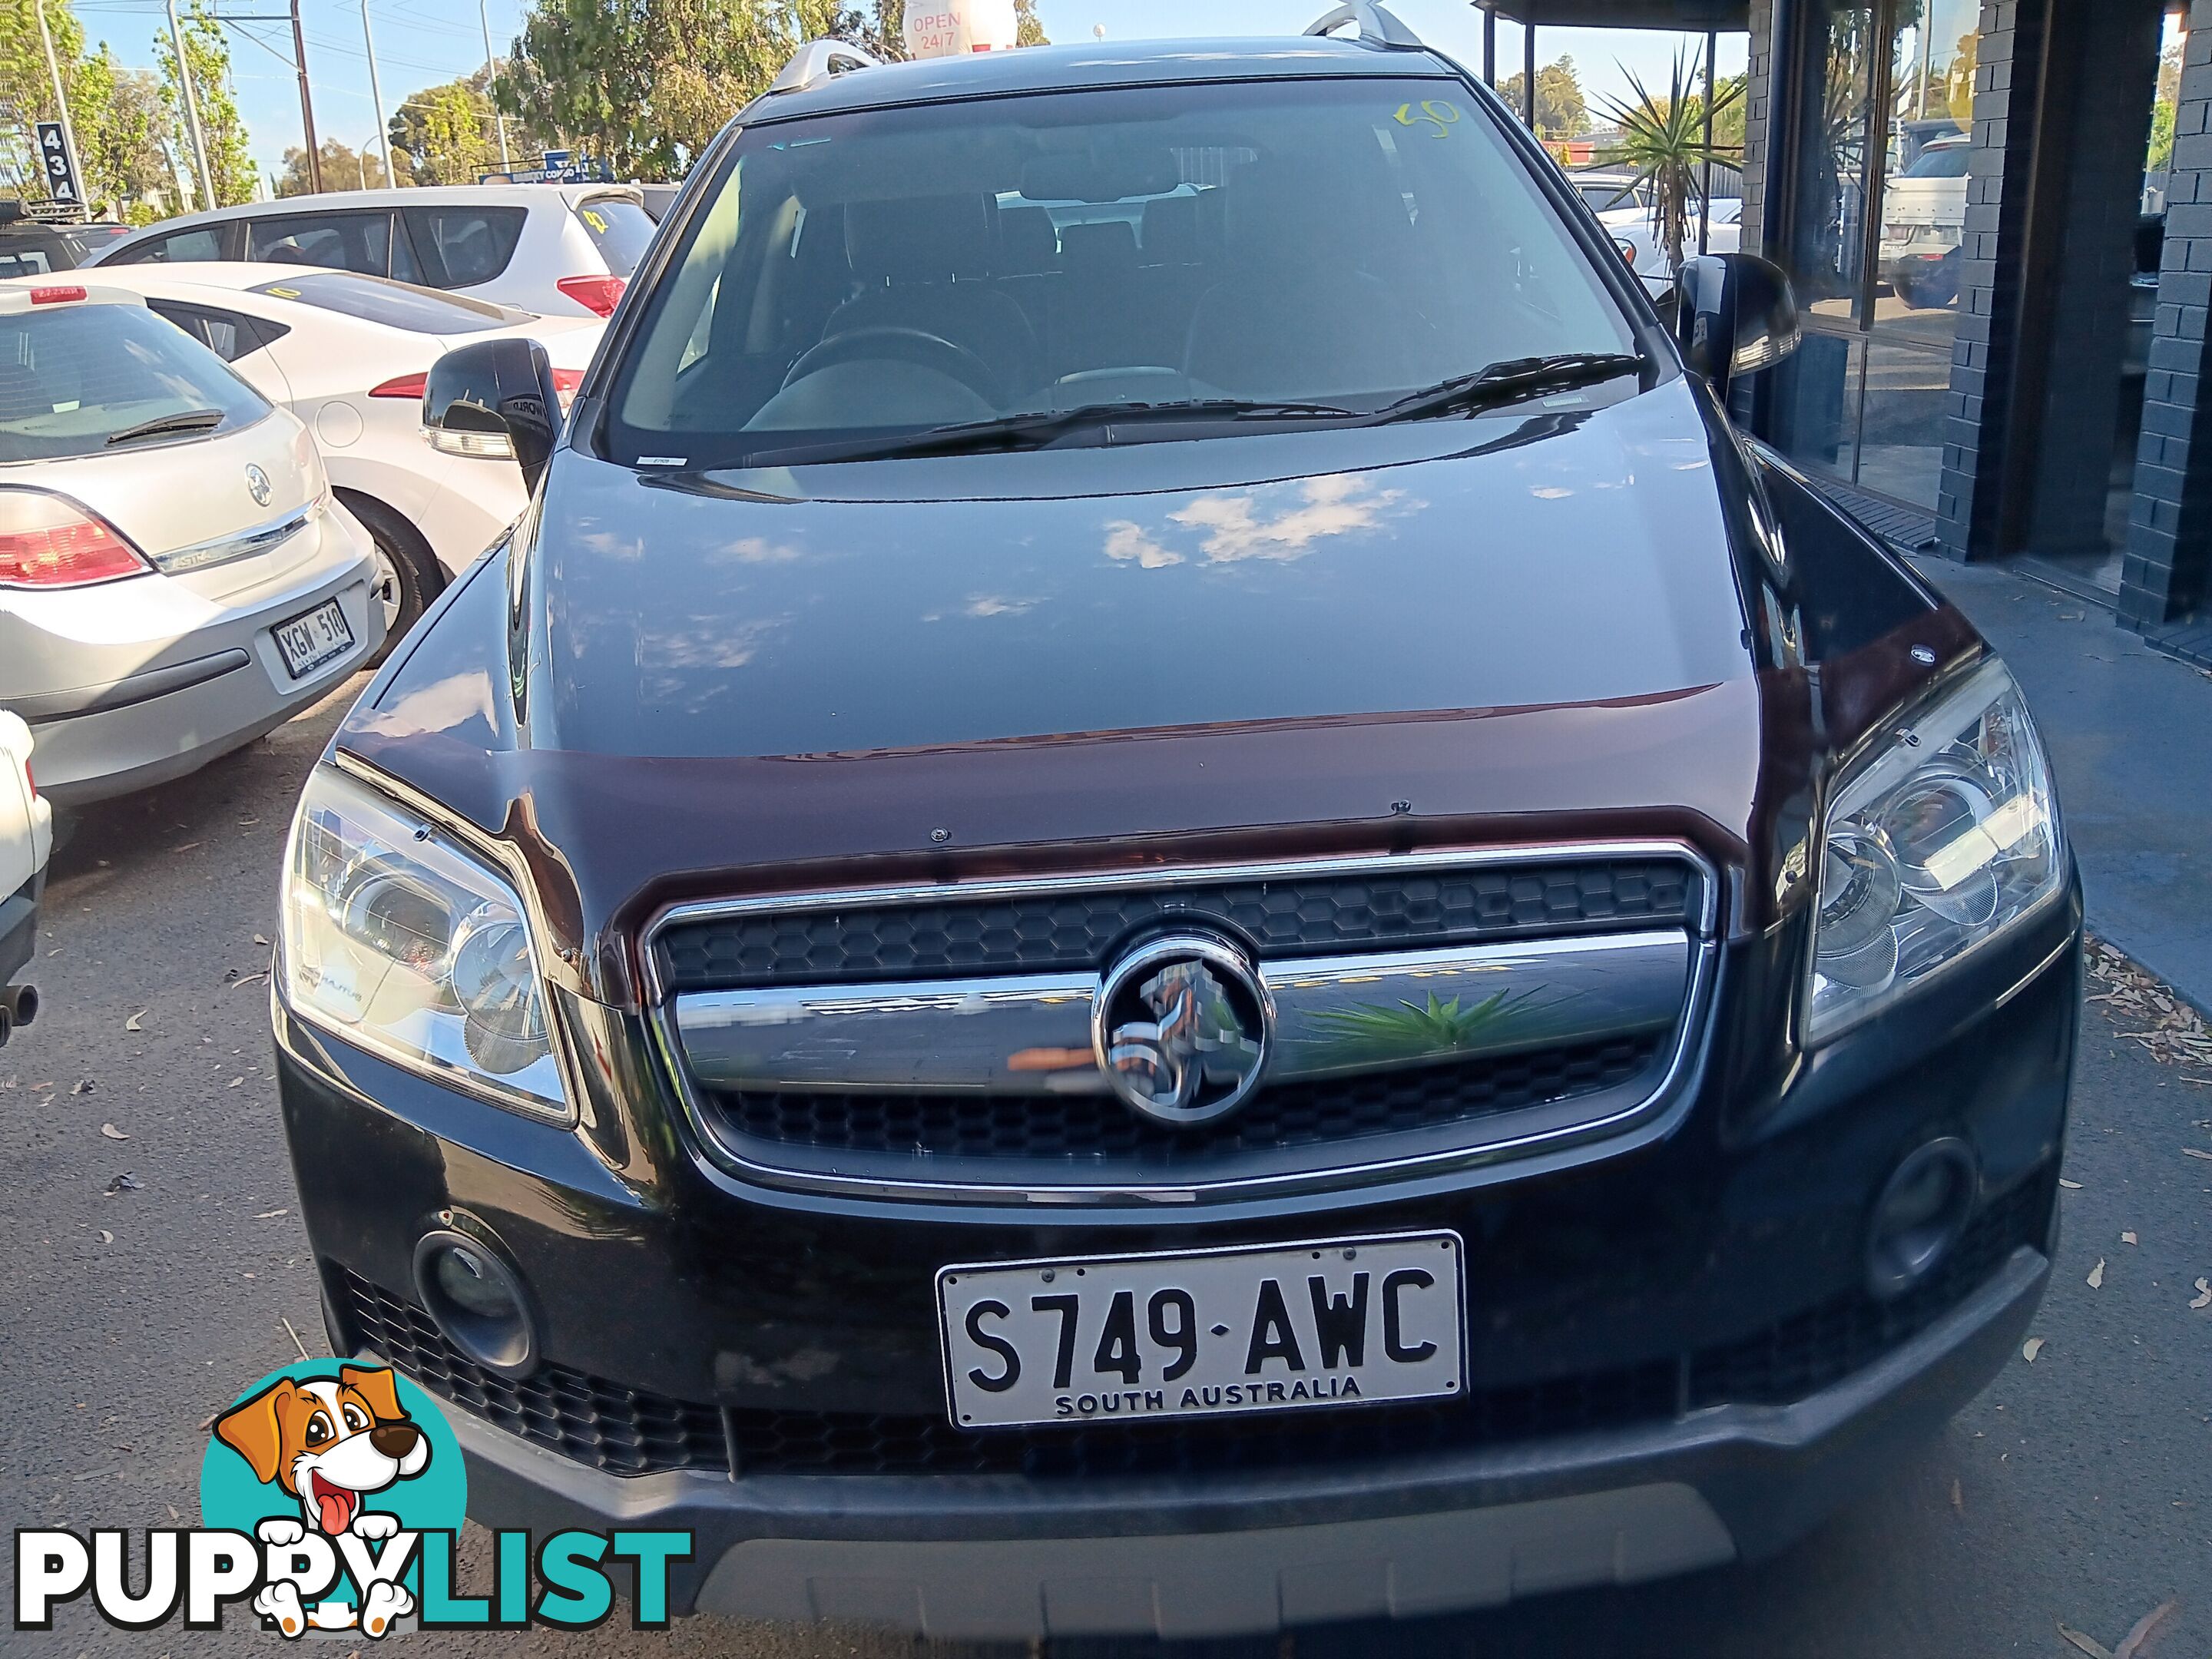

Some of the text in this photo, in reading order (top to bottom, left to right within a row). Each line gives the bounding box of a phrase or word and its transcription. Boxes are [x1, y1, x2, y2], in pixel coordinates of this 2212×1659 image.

[914, 12, 960, 32] OPEN
[922, 32, 954, 50] 24/7
[281, 621, 316, 662] XGW
[316, 608, 345, 641] 510
[1055, 1376, 1362, 1416] SOUTH AUSTRALIA
